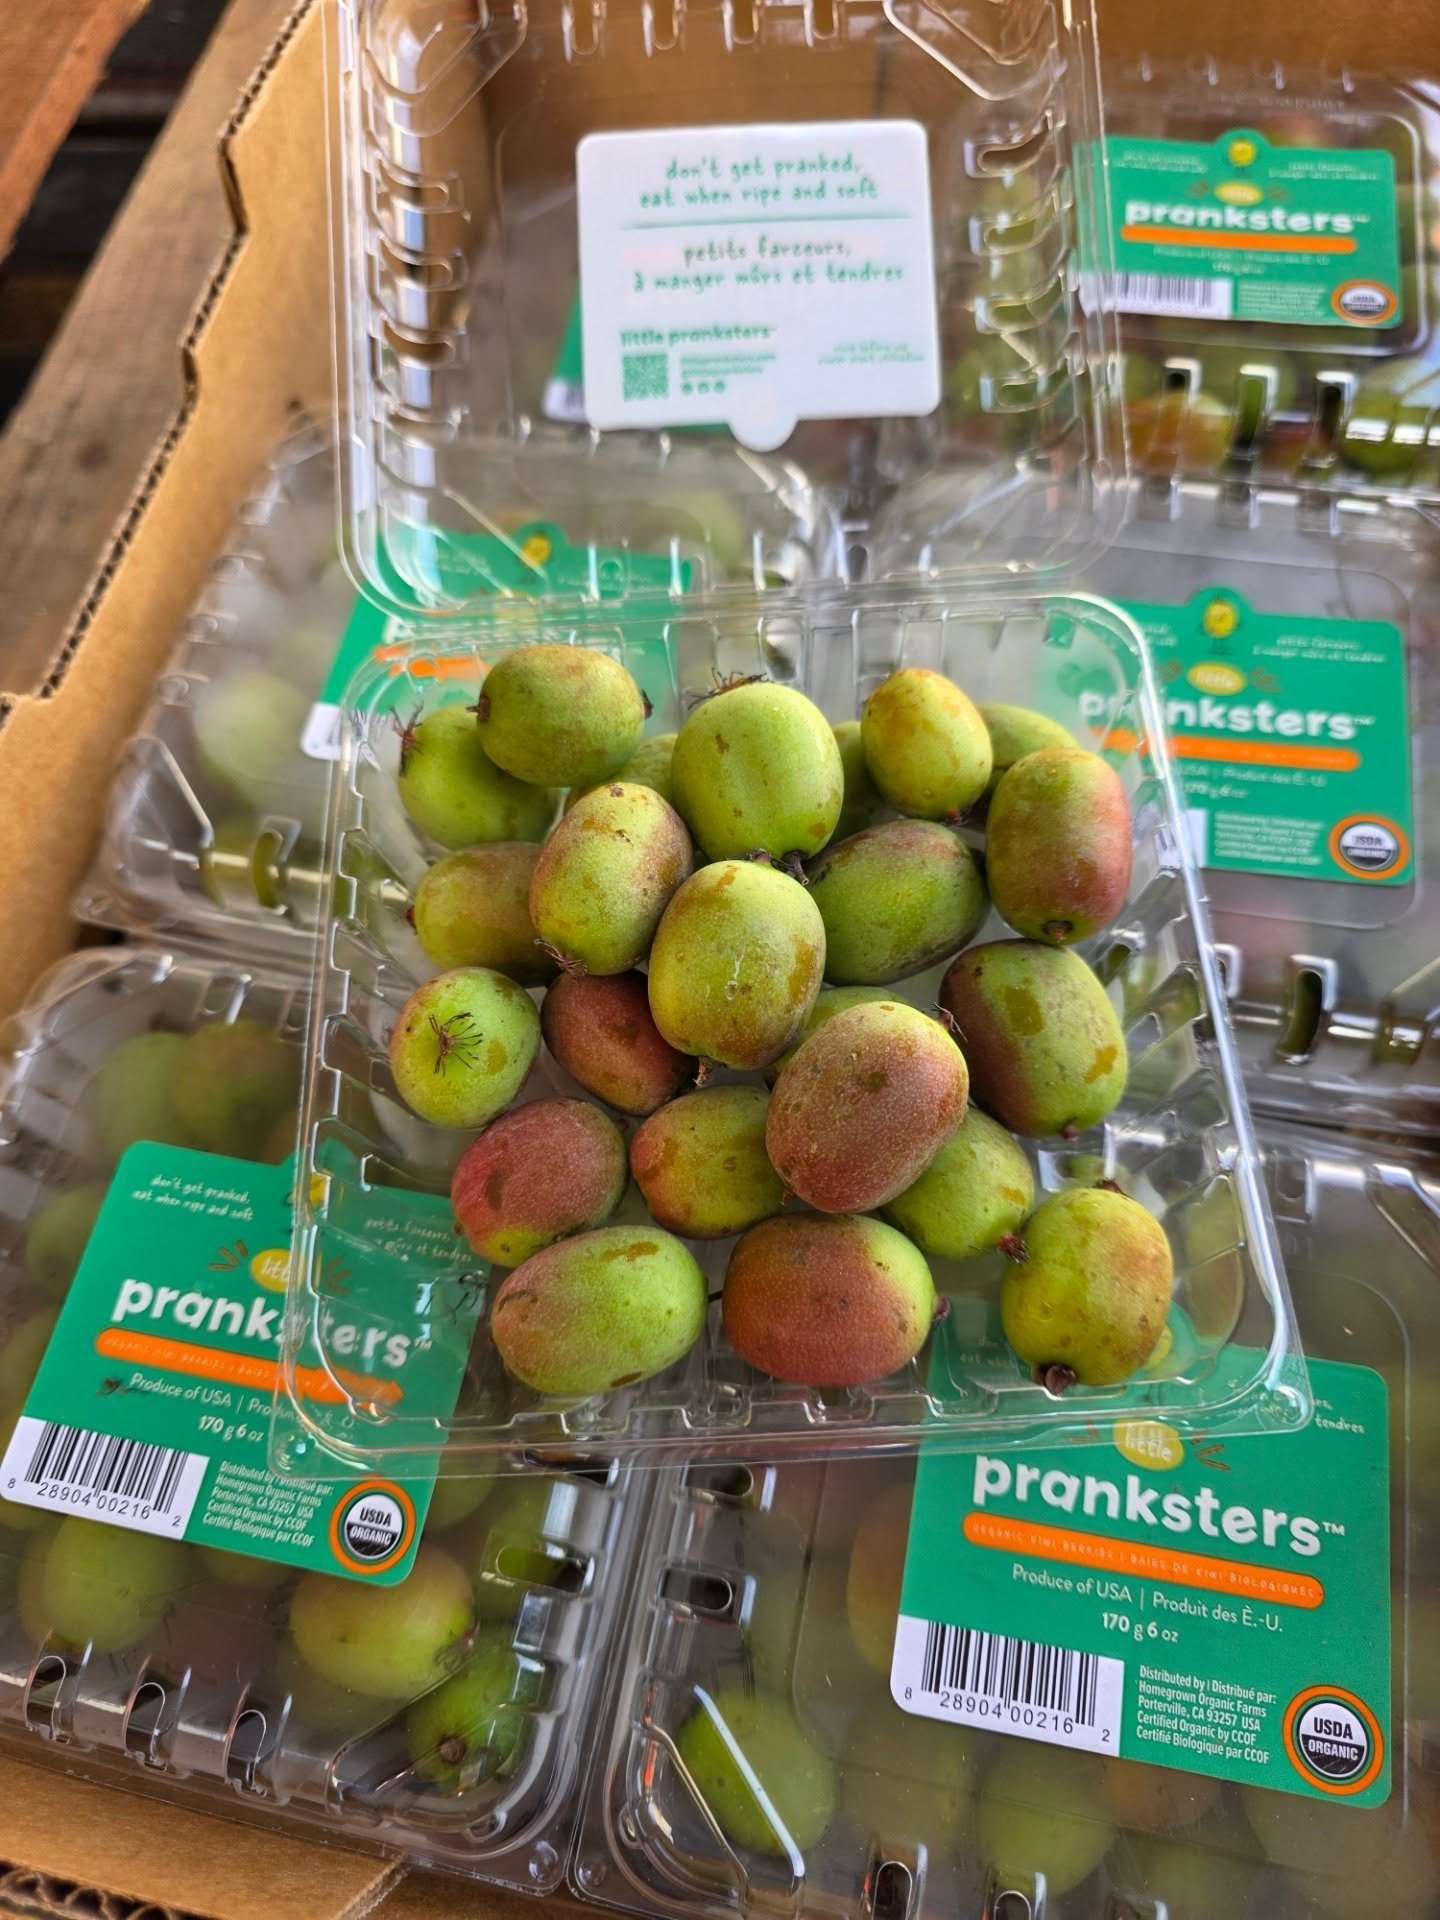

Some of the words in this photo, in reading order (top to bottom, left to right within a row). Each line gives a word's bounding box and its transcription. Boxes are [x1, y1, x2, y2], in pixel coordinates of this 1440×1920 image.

[666, 157, 720, 179] don't
[731, 156, 764, 182] get
[774, 151, 860, 179] pranked,
[640, 187, 674, 208] eat
[685, 185, 731, 204] when
[741, 187, 782, 208] ripe
[792, 180, 826, 199] and
[837, 175, 878, 198] soft
[684, 241, 747, 267] petits
[655, 273, 724, 294] manger
[792, 263, 815, 284] et
[826, 261, 904, 283] tendres
[620, 329, 664, 347] little
[151, 1174, 182, 1190] don't
[182, 1182, 204, 1195] get
[132, 1189, 153, 1201] eat
[155, 1194, 180, 1206] when
[207, 1204, 230, 1216] and
[229, 1206, 253, 1221] soft
[129, 1372, 183, 1396] Produce
[184, 1385, 202, 1400] of
[201, 1387, 232, 1407] USA
[199, 1414, 225, 1434] 170
[223, 1425, 235, 1441] g
[236, 1423, 248, 1438] 6
[248, 1430, 265, 1443] oz
[1313, 1413, 1366, 1434] tendres
[219, 1460, 265, 1480] Distributed
[7, 1478, 17, 1489] 8
[37, 1481, 93, 1507] 28904
[96, 1494, 152, 1521] 00216
[172, 1515, 183, 1528] 2
[215, 1473, 265, 1494] Homegrown
[265, 1484, 297, 1501] Organic
[297, 1492, 323, 1509] Farms
[207, 1500, 243, 1517] Certified
[241, 1508, 274, 1527] Organic
[272, 1515, 286, 1530] by
[285, 1516, 309, 1531] CCOF
[256, 1495, 269, 1509] CA
[267, 1497, 296, 1515] 93257
[296, 1504, 315, 1520] USA
[359, 1507, 393, 1528] USDA
[232, 1519, 278, 1542] Biologique
[276, 1530, 293, 1545] par
[291, 1531, 316, 1548] CCOF
[349, 1526, 394, 1547] ORGANIC
[971, 1522, 1024, 1542] ORGANIC
[1030, 1535, 1057, 1549] KIWI
[1062, 1541, 1114, 1560] BERRIES
[1130, 1551, 1167, 1570] BAIES
[1172, 1560, 1190, 1574] DE
[1012, 1563, 1073, 1592] Produce
[1076, 1577, 1097, 1595] of
[1096, 1581, 1133, 1603] USA
[1152, 1591, 1209, 1619] Produit
[1211, 1604, 1238, 1624] des
[1101, 1611, 1131, 1633] 170
[1133, 1623, 1144, 1642] g
[1147, 1621, 1159, 1638] 6
[1161, 1629, 1180, 1643] oz
[1139, 1664, 1193, 1687] Distributed
[1192, 1674, 1206, 1692] by
[1210, 1678, 1255, 1700] Distribué
[1256, 1690, 1278, 1705] par:
[1139, 1680, 1197, 1702] Homegrown
[1197, 1692, 1235, 1713] Organic
[1236, 1700, 1268, 1718] Farms
[904, 1686, 913, 1700] 8
[939, 1690, 1003, 1720] 28904
[1009, 1705, 1074, 1734] 00216
[1101, 1728, 1111, 1743] 2
[1137, 1710, 1179, 1731] Certified
[1179, 1720, 1216, 1741] Organic
[1216, 1728, 1231, 1743] by
[1231, 1728, 1257, 1746] CCOF
[1138, 1695, 1190, 1718] Porterville,
[1191, 1706, 1206, 1721] CA
[1206, 1709, 1238, 1727] 93257
[1241, 1716, 1261, 1731] USA
[1313, 1716, 1354, 1741] USDA
[1136, 1725, 1173, 1744] Certifié
[1172, 1733, 1225, 1756] Biologique
[1224, 1745, 1244, 1761] par
[1244, 1746, 1270, 1764] CCOF
[1308, 1739, 1359, 1761] ORGANIC
